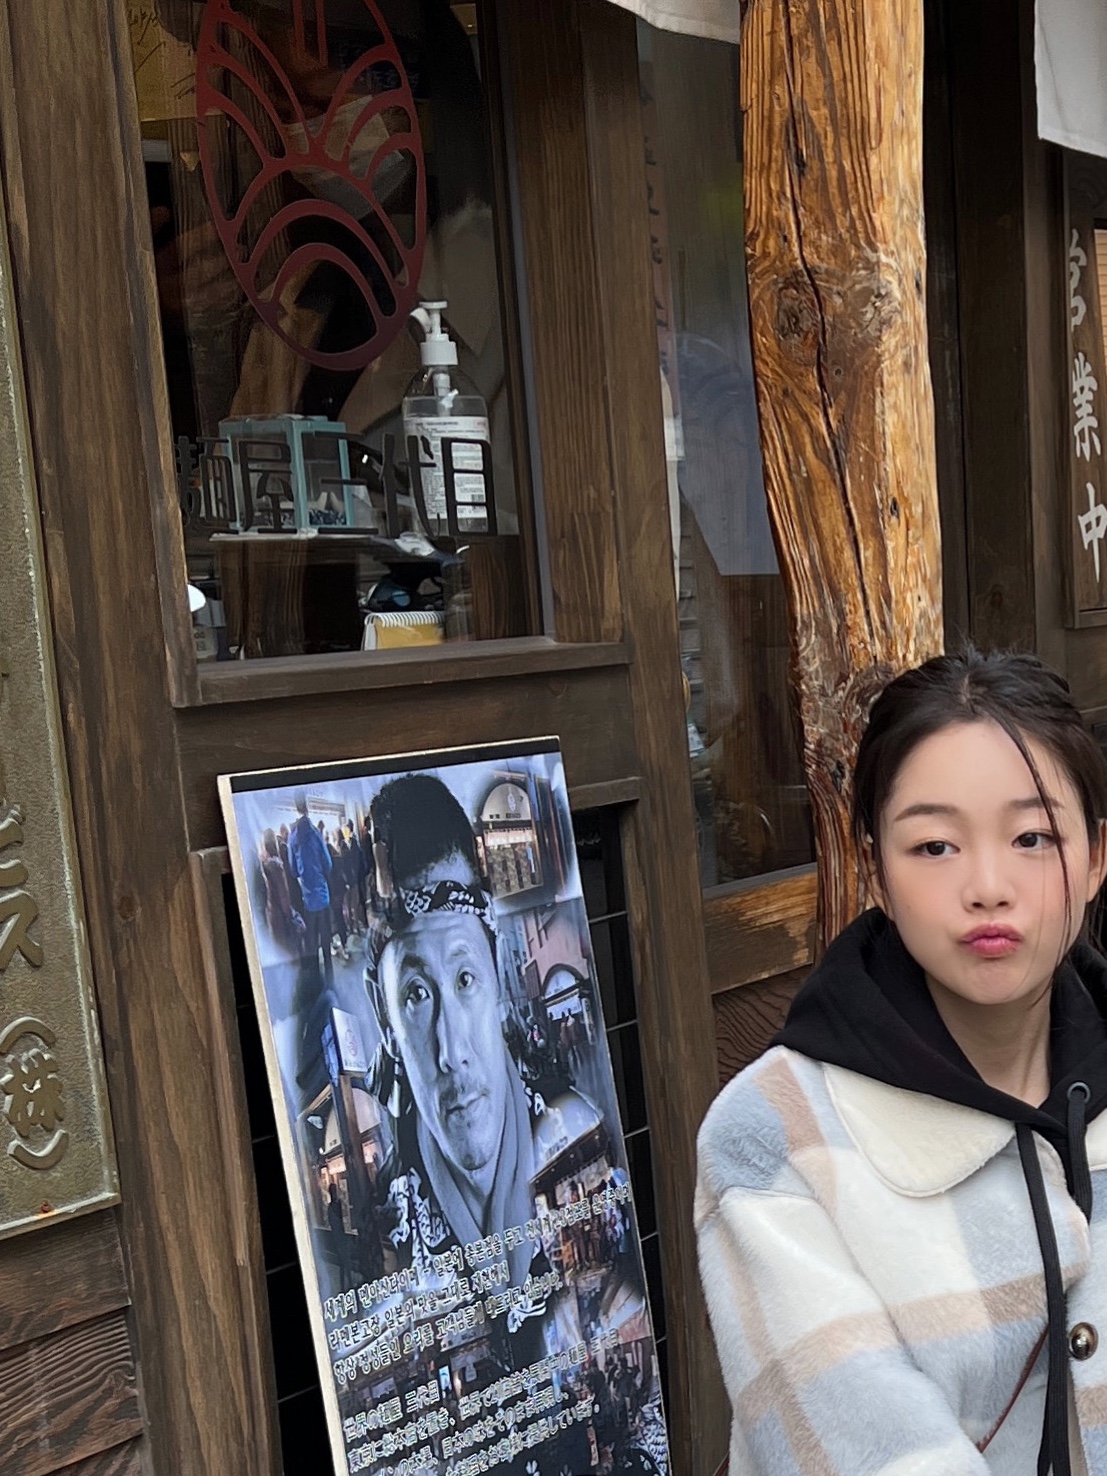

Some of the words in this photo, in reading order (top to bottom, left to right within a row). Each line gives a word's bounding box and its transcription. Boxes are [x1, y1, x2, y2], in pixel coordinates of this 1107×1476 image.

[324, 1290, 358, 1321] 세계의
[433, 1247, 465, 1276] 일본에
[504, 1225, 524, 1248] 두고
[442, 1277, 471, 1303] 그대로
[334, 1356, 360, 1383] 항상
[403, 1323, 434, 1354] 요리를
